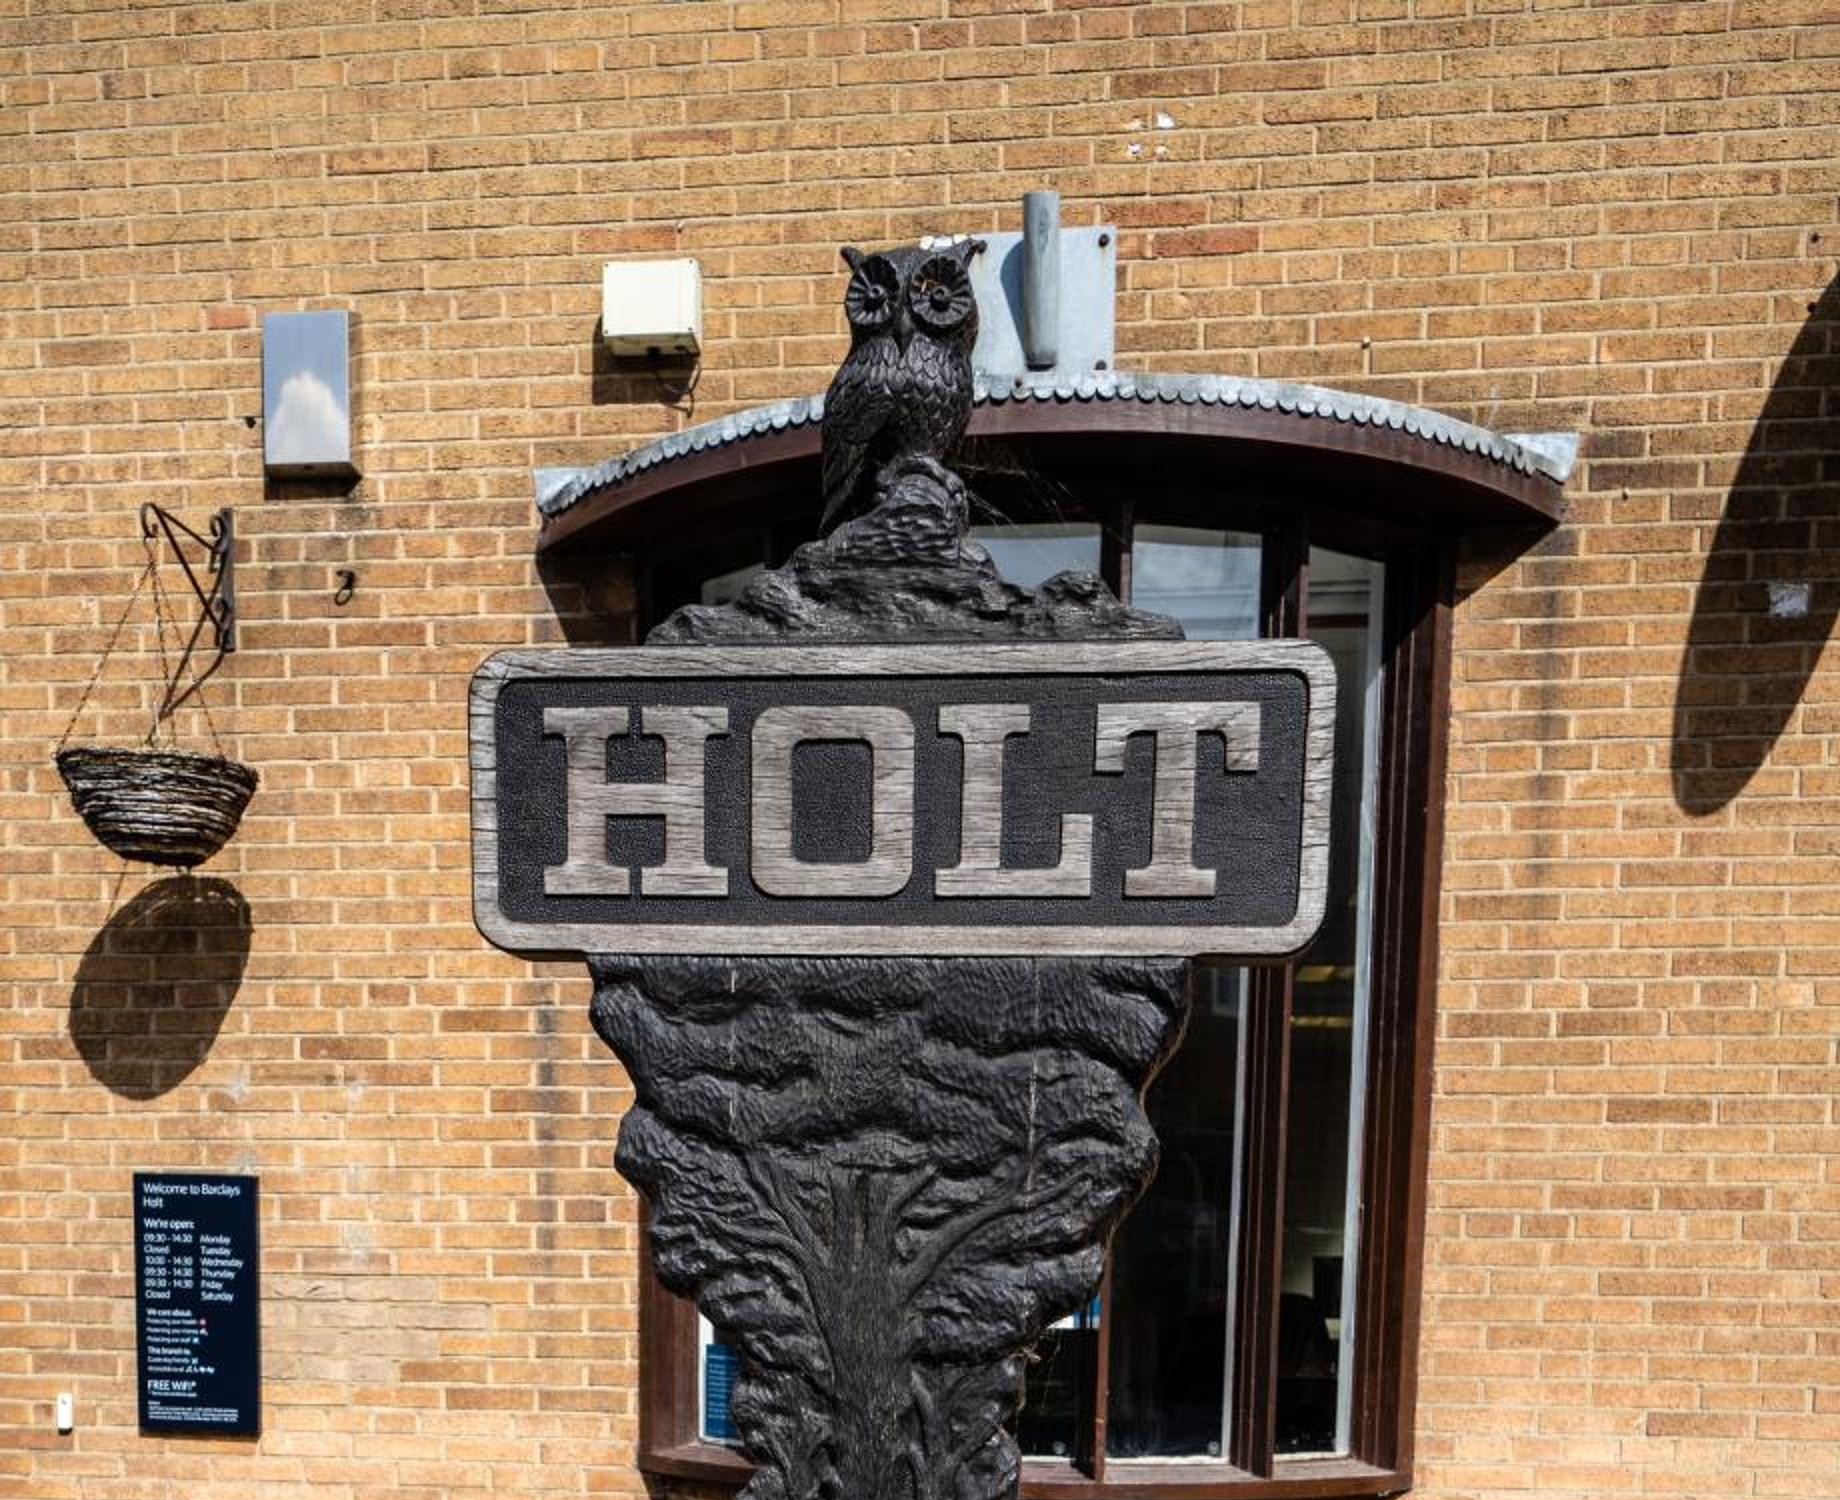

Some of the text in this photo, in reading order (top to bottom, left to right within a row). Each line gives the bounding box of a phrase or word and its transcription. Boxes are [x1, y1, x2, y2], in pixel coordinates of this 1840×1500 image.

[543, 701, 1261, 898] HOLT
[143, 1182, 241, 1198] Welcome to Barclays
[143, 1196, 163, 1208] Holt
[200, 1234, 231, 1246] Monday
[144, 1244, 170, 1254] Closed
[200, 1245, 231, 1257] Tuesday
[200, 1256, 243, 1269] Wednesday
[201, 1267, 236, 1280] Thursday
[201, 1279, 224, 1290] Friday
[145, 1289, 171, 1299] Closed
[201, 1290, 234, 1302] Saturday
[147, 1379, 170, 1391] FREE
